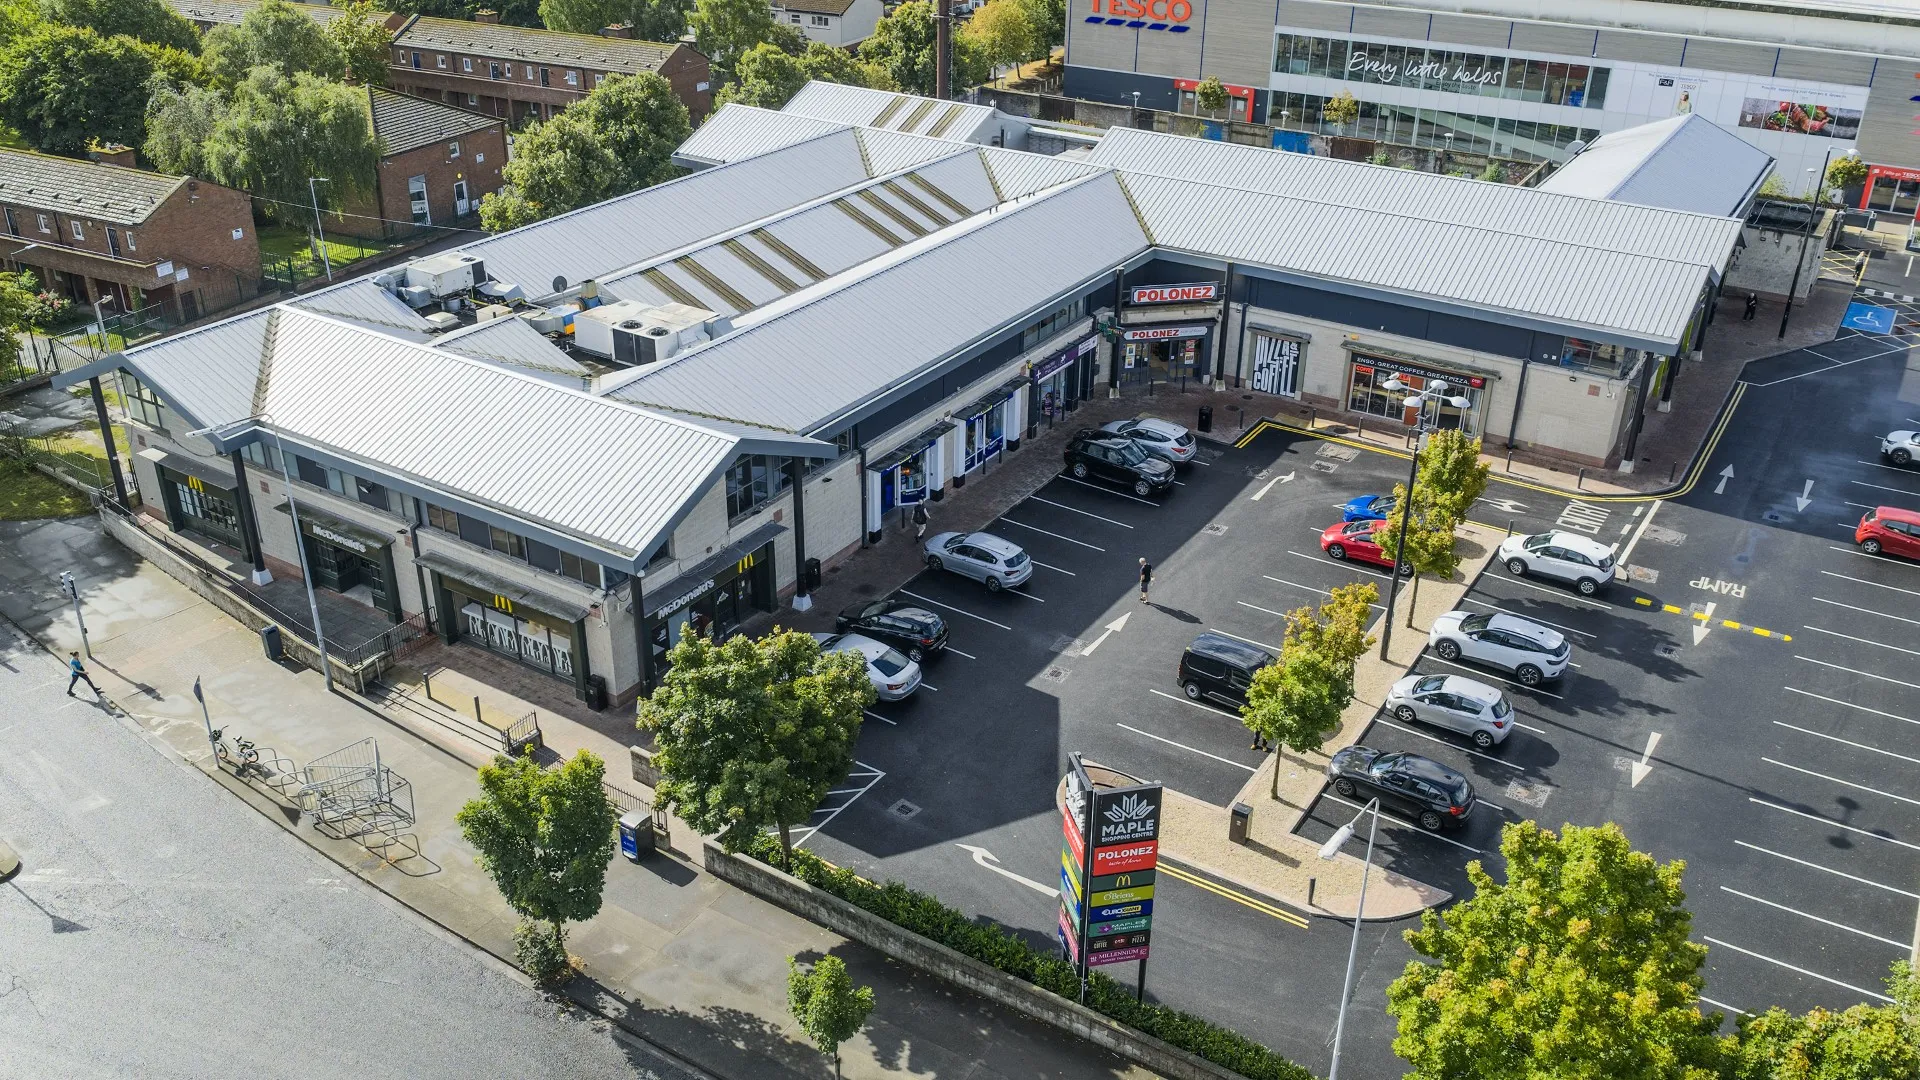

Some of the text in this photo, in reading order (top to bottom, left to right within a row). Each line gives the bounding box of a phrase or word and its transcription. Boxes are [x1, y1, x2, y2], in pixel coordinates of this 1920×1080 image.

[1348, 52, 1501, 89] Every little helps
[1137, 286, 1213, 302] POLONEZ
[1132, 329, 1180, 339] POLONEZ
[1253, 335, 1290, 372] PIZZA
[1253, 353, 1298, 398] COFFEE
[1377, 361, 1399, 370] GREAT
[1427, 371, 1449, 380] GREAT
[1555, 499, 1612, 535] ENTRY
[313, 525, 366, 553] McDonald's
[1689, 576, 1747, 599] RAMP
[658, 579, 715, 620] McDonald's
[1101, 831, 1154, 842] SHOPPING CENTRE
[1102, 819, 1154, 836] MAPLE
[1097, 846, 1154, 860] POLONEZ
[1132, 936, 1146, 944] PIZZA
[1099, 948, 1139, 959] MILLENNIUM
